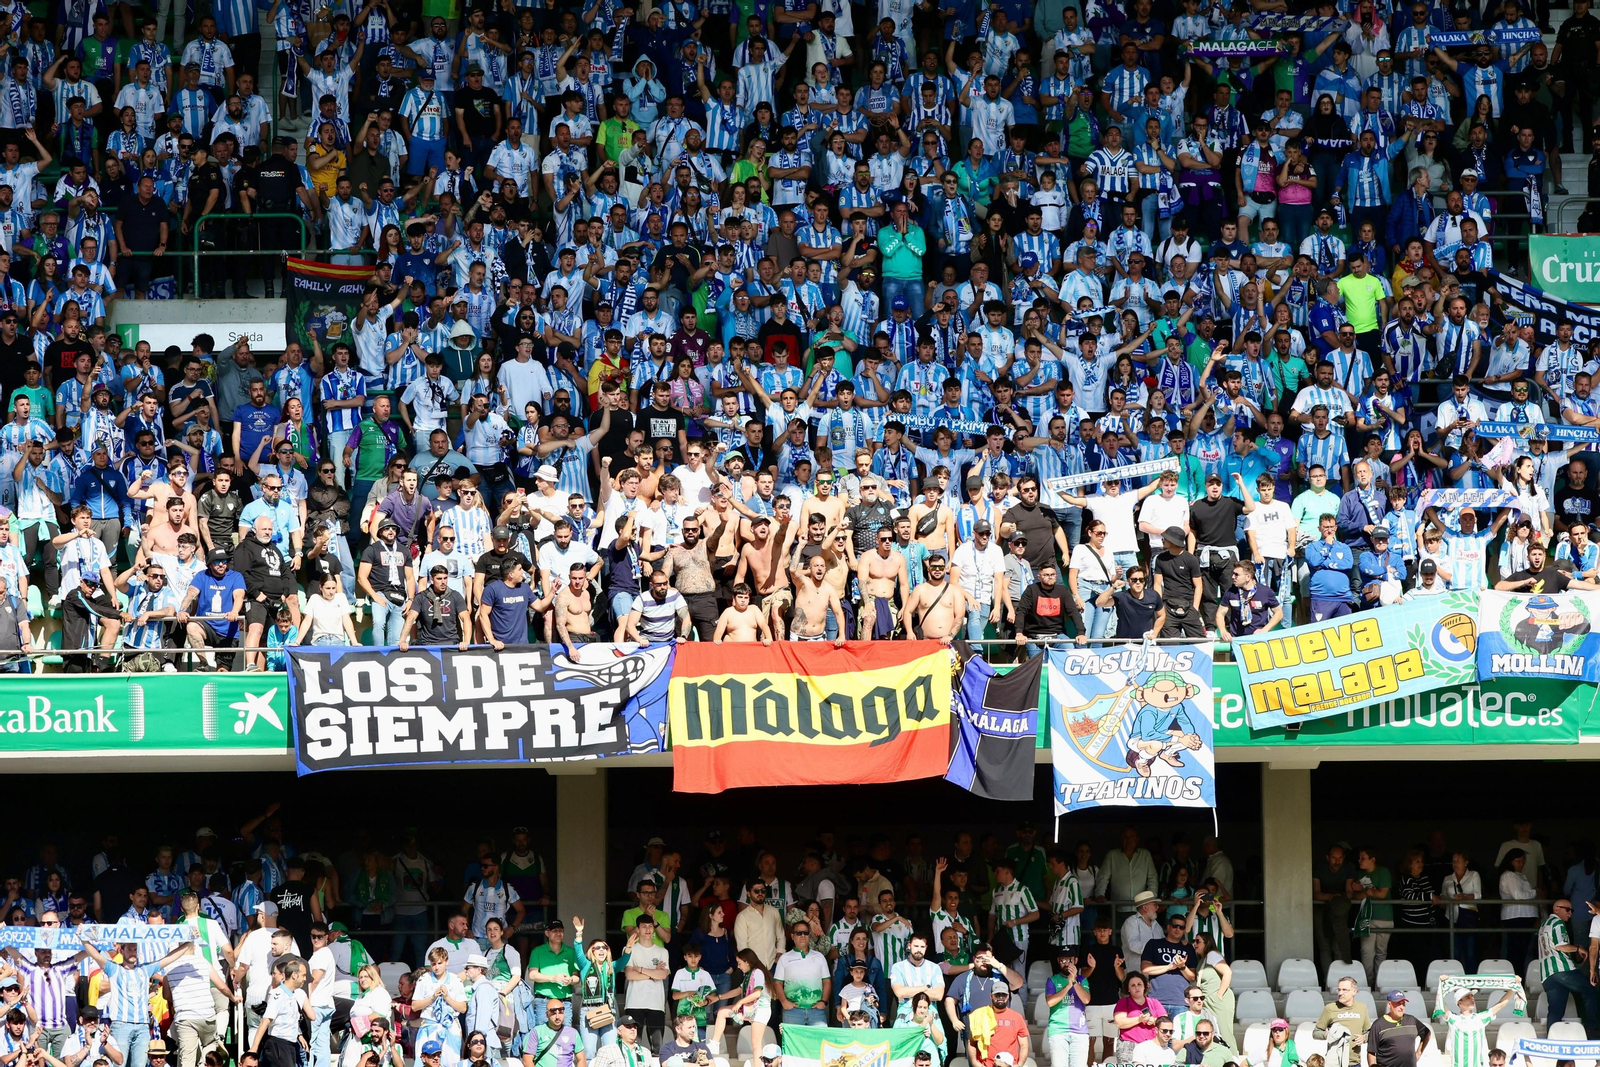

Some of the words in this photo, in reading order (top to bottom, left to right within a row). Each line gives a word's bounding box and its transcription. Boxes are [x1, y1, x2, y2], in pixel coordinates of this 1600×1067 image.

[1430, 34, 1467, 47] MALAKA
[1502, 29, 1540, 43] HINCHAS
[1100, 166, 1126, 177] MALAGA
[294, 277, 329, 293] FAMILY
[1496, 282, 1558, 315] PEÑA
[123, 329, 133, 343] 1
[228, 331, 263, 342] Salida
[1478, 425, 1515, 435] MALAKA
[1556, 428, 1597, 439] HINCHAS
[1437, 492, 1484, 504] MALAGA
[1240, 618, 1383, 674] nueva
[1064, 650, 1194, 676] CASUALS
[1491, 653, 1584, 676] MOLLINA
[298, 655, 433, 704] LOS
[451, 652, 546, 699] DE
[1249, 647, 1425, 717] malaga
[684, 674, 940, 747] Málaga
[1311, 703, 1338, 713] FRENTE
[304, 687, 622, 761] SIEMPRE
[967, 711, 1029, 732] MÁLAGA
[1060, 776, 1203, 806] TEATINOS
[103, 927, 183, 941] MALAGA
[1523, 1041, 1559, 1053] PORQUE
[1562, 1043, 1571, 1053] TE
